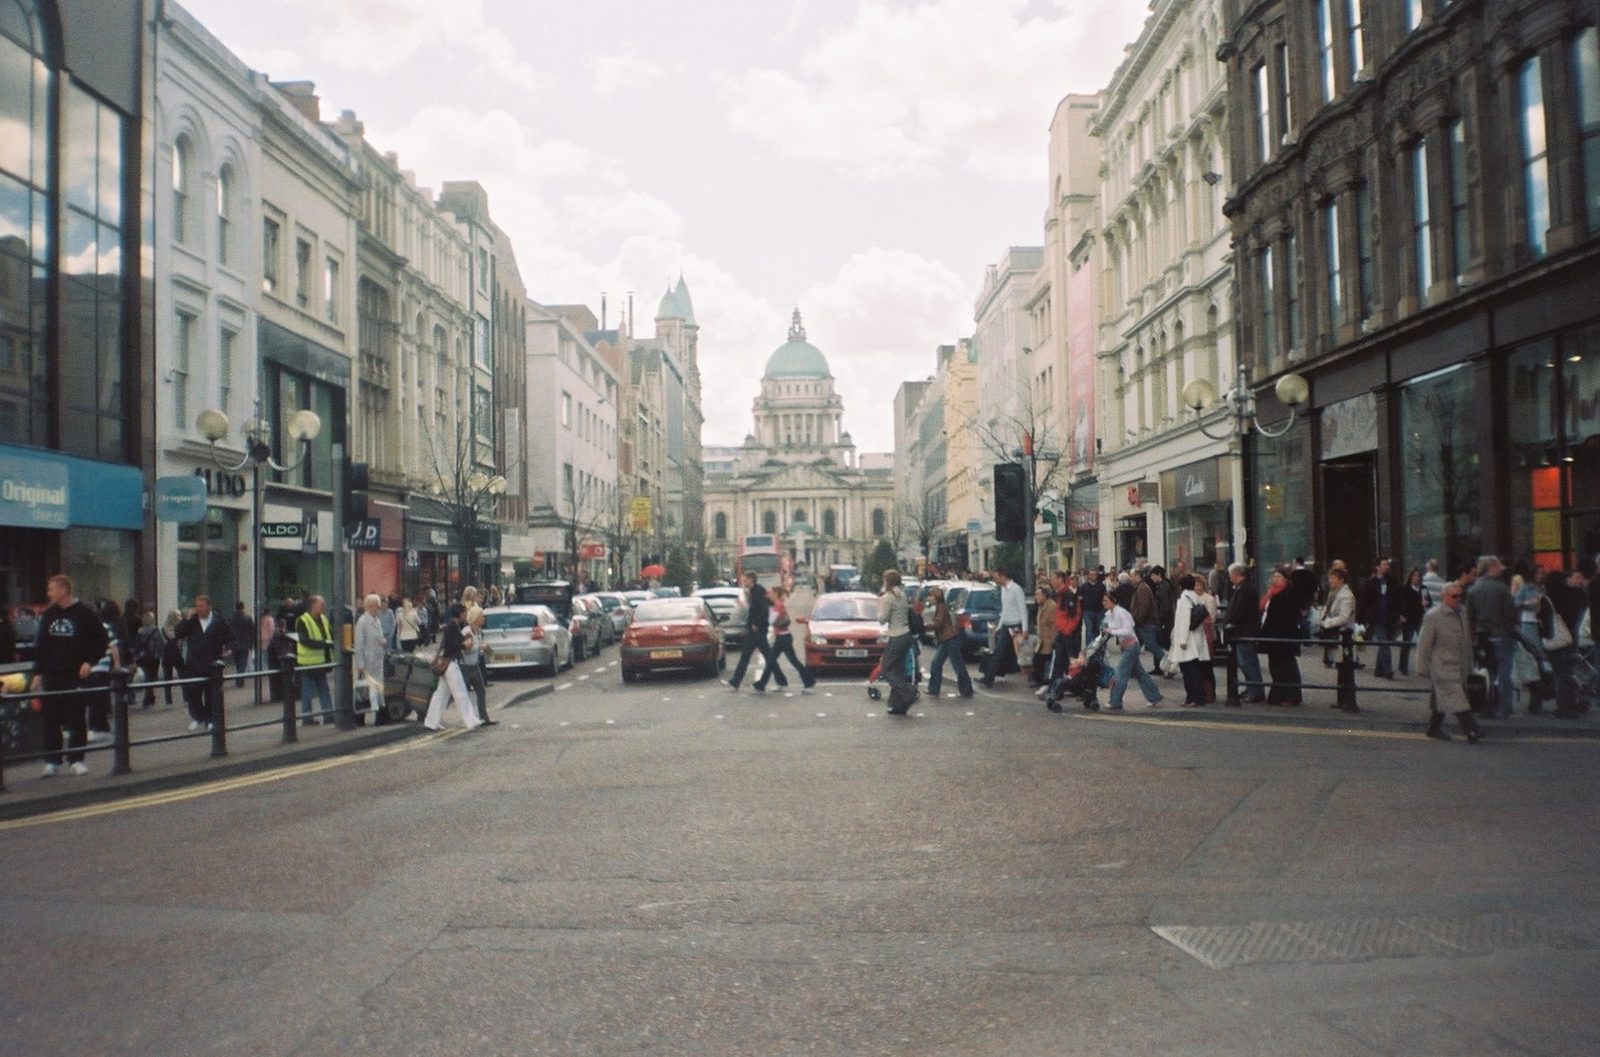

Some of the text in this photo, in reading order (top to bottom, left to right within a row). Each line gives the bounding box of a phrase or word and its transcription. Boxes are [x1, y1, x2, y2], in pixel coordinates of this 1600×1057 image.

[2, 479, 66, 508] Original
[260, 525, 298, 535] ALDO
[351, 521, 377, 539] JD
